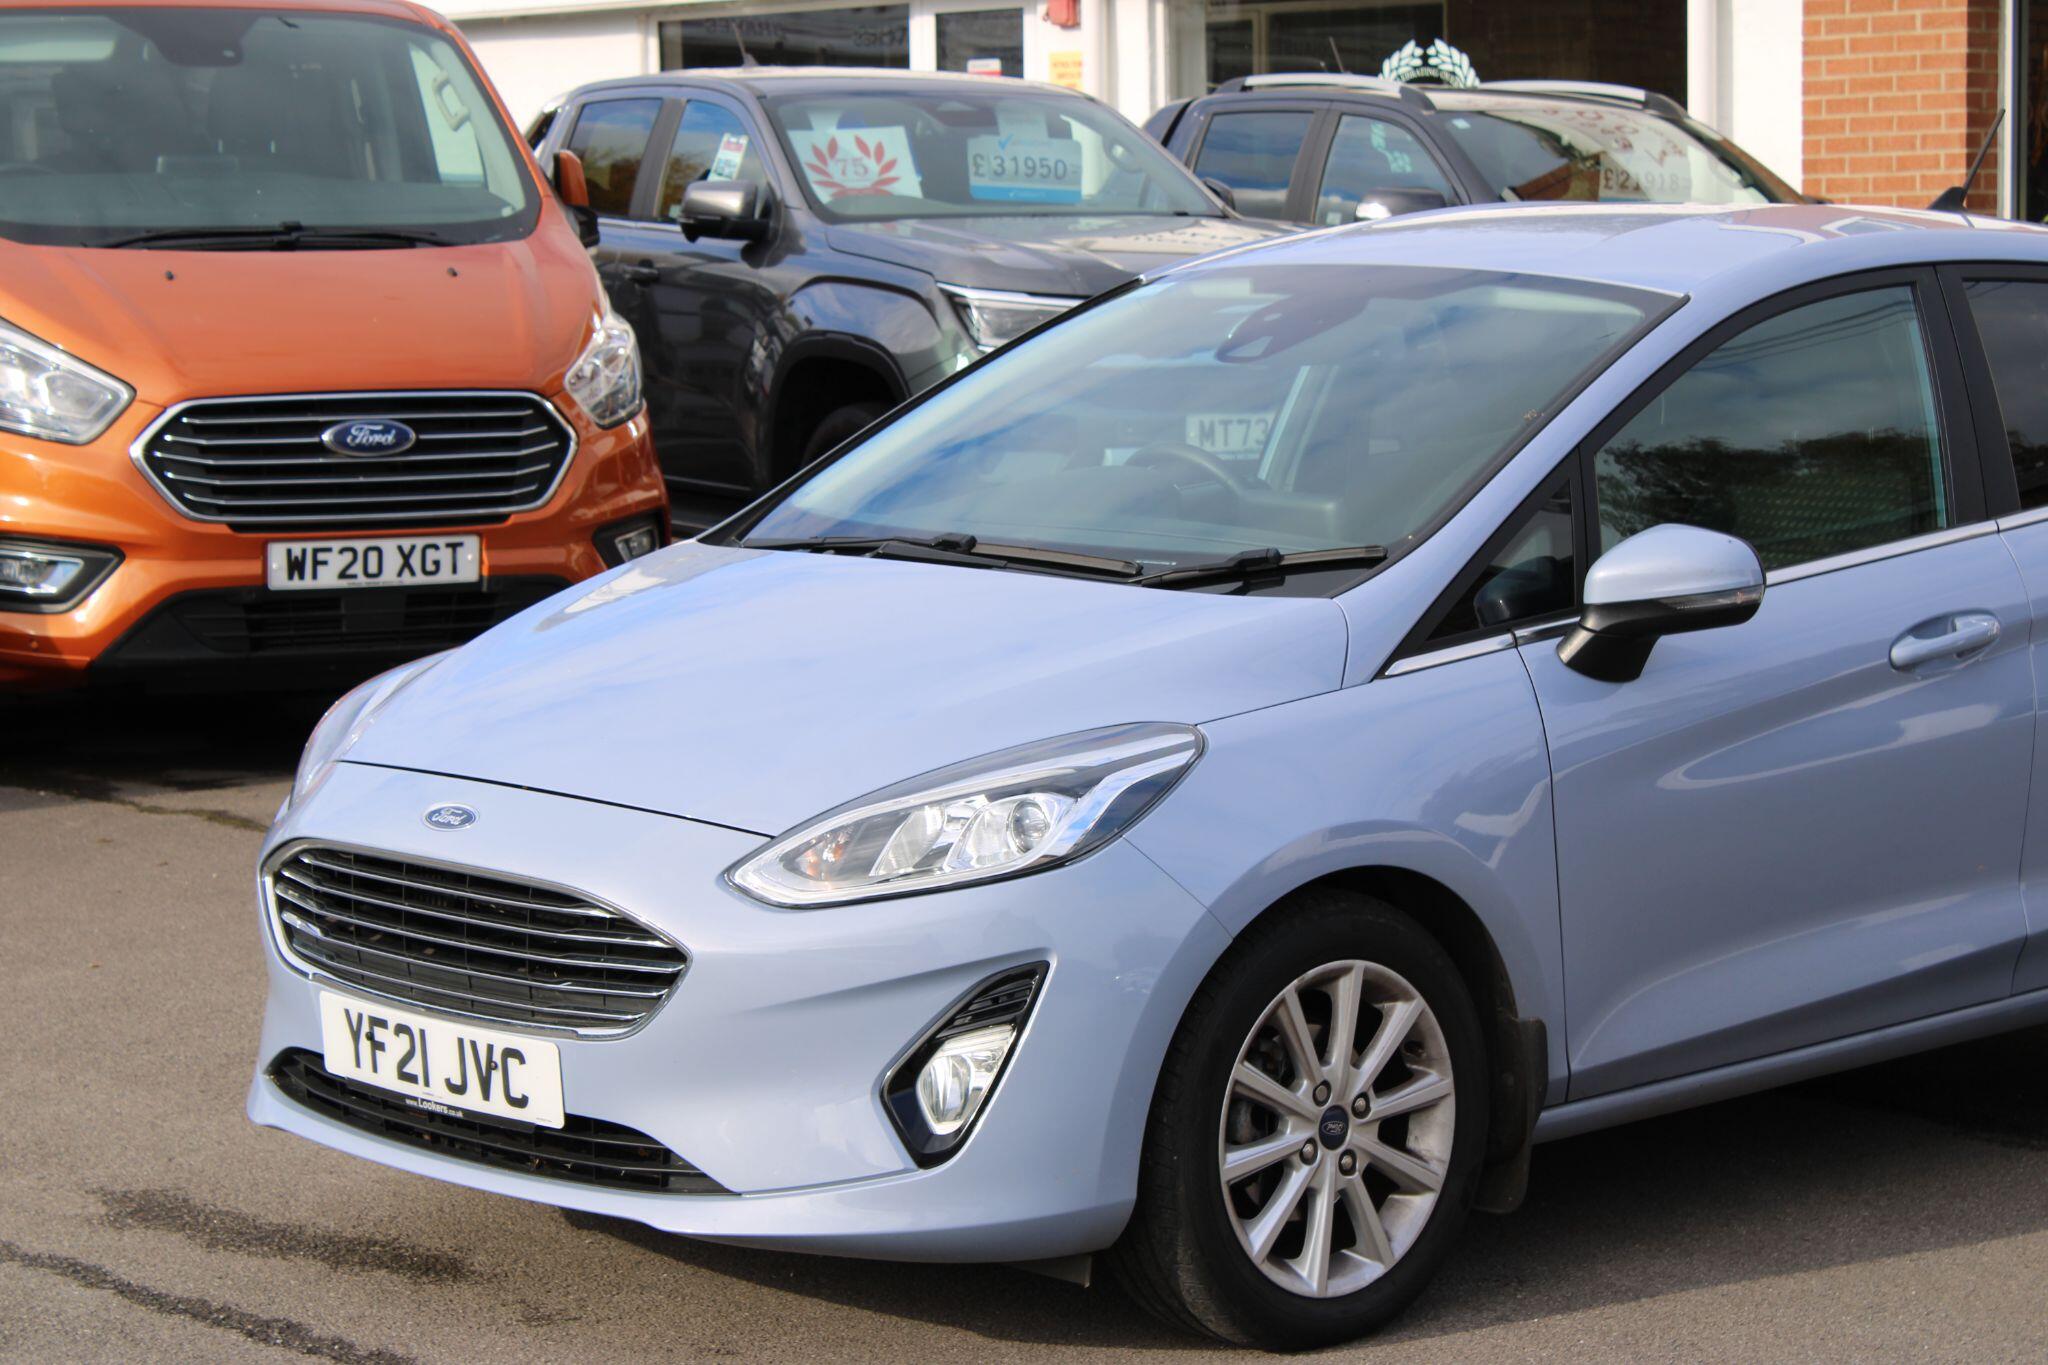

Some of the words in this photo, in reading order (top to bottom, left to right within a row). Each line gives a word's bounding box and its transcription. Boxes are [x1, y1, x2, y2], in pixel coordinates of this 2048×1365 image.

[835, 157, 869, 178] 75
[346, 424, 396, 446] Ford
[286, 546, 384, 581] WF20
[397, 541, 464, 578] XGT
[431, 808, 468, 825] Ford
[344, 1008, 430, 1088] YF21
[444, 1037, 529, 1109] JVC
